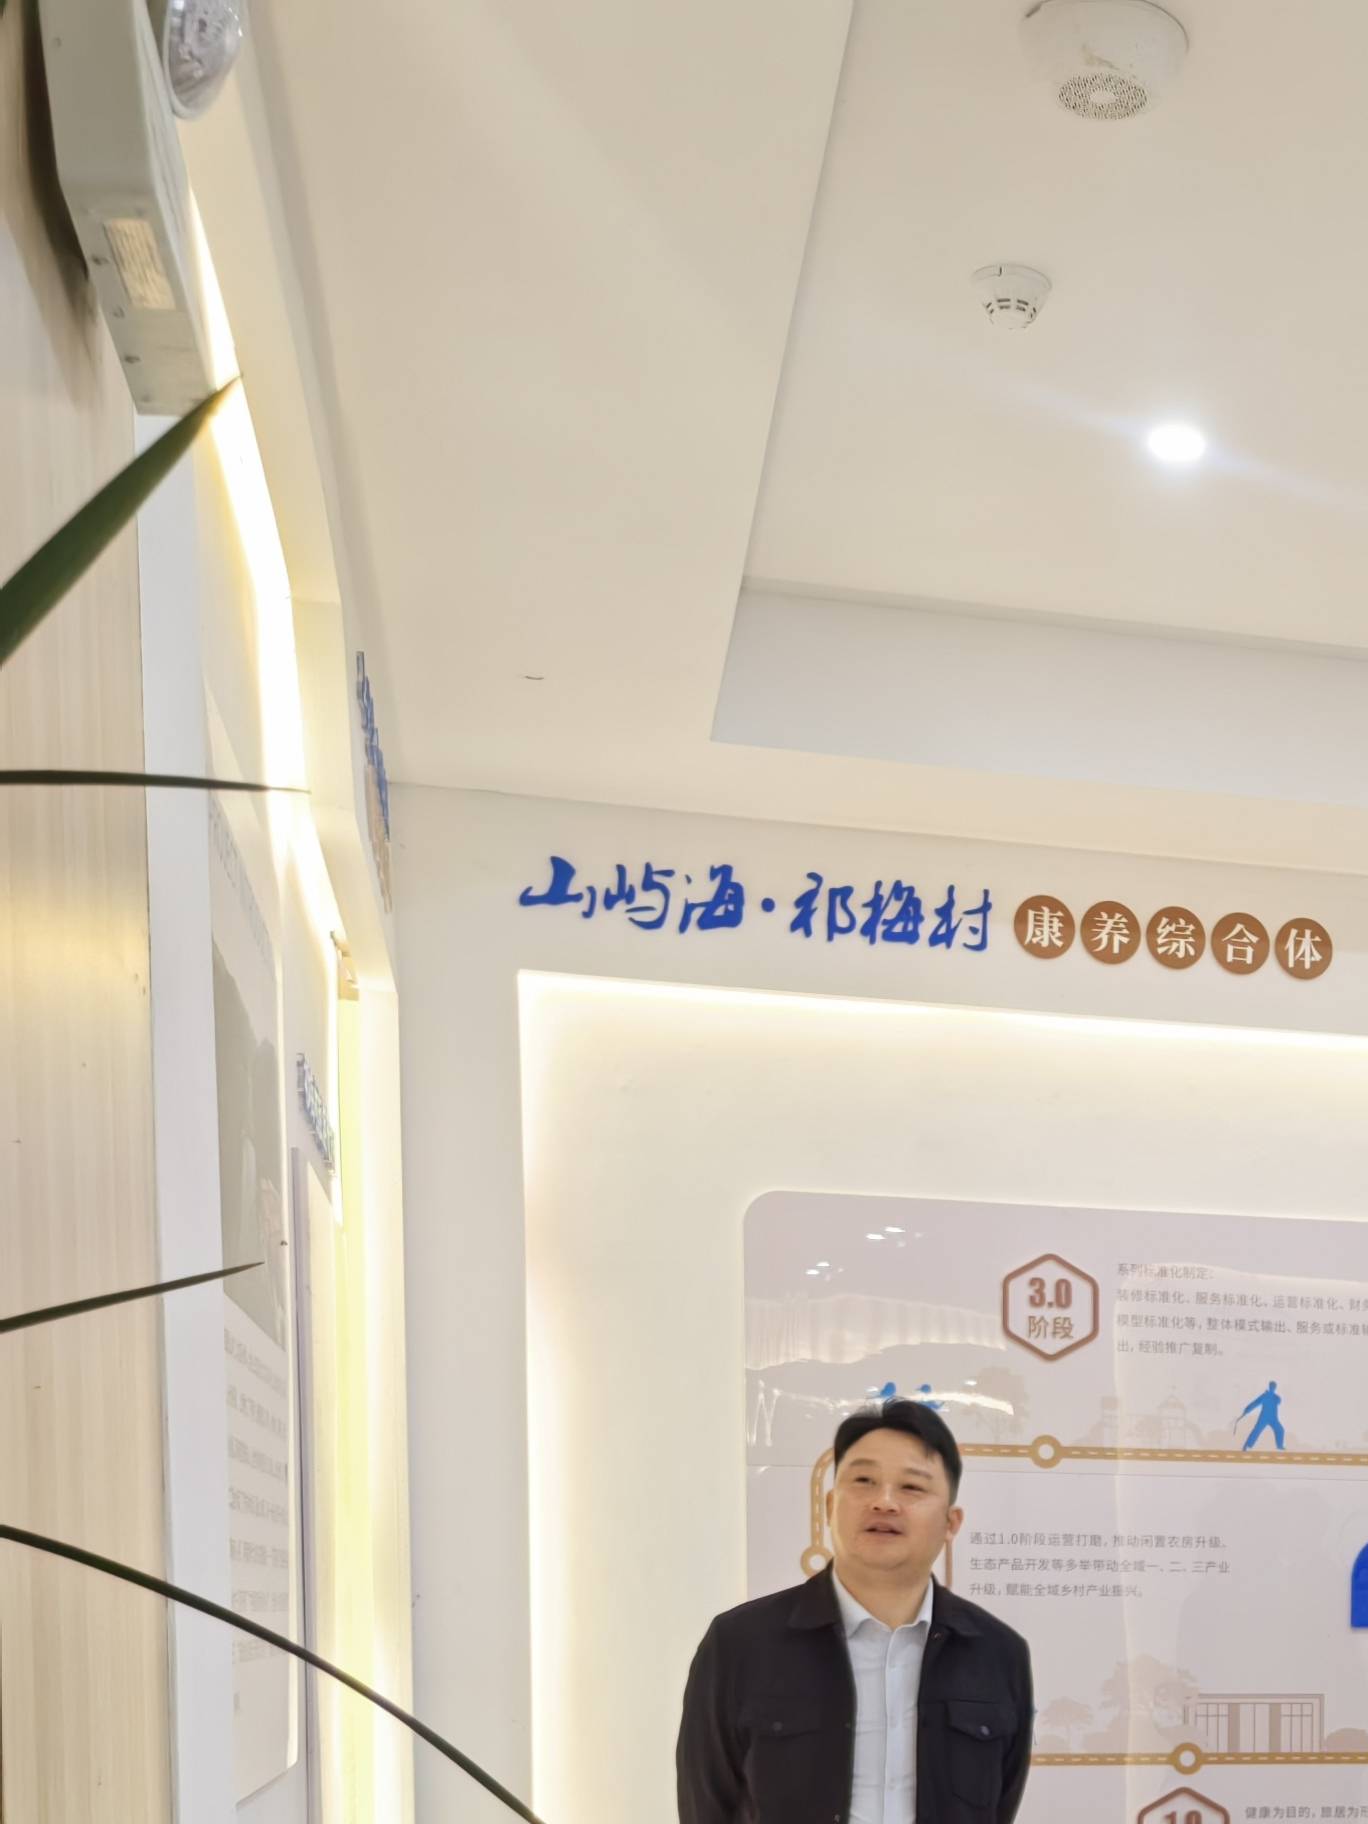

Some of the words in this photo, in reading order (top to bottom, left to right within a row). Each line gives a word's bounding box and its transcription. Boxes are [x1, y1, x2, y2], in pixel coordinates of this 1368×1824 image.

[1023, 906, 1323, 970] 康养综合体
[1028, 1277, 1073, 1309] 3.0
[1027, 1315, 1075, 1340] 阶段
